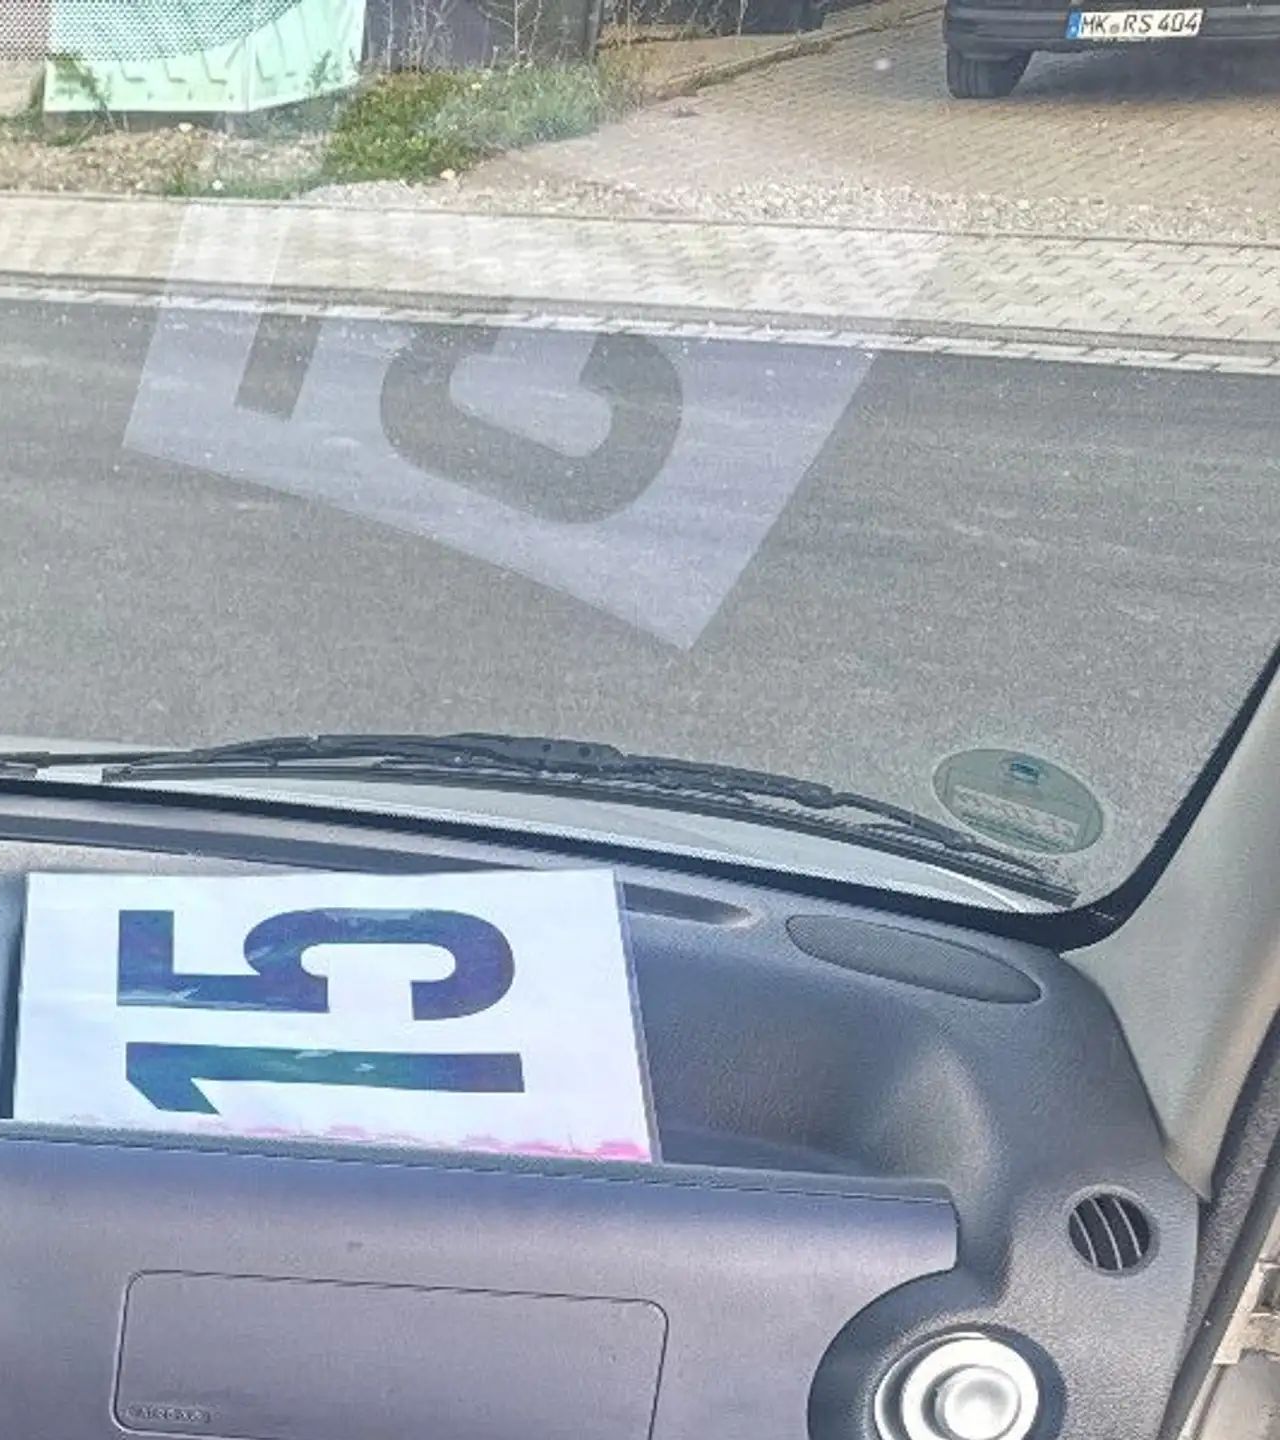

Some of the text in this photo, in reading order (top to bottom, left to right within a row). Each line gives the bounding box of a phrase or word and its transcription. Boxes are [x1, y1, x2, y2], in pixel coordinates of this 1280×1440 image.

[1123, 14, 1153, 34] RS
[1158, 12, 1198, 33] 404
[116, 907, 525, 1114] 15
